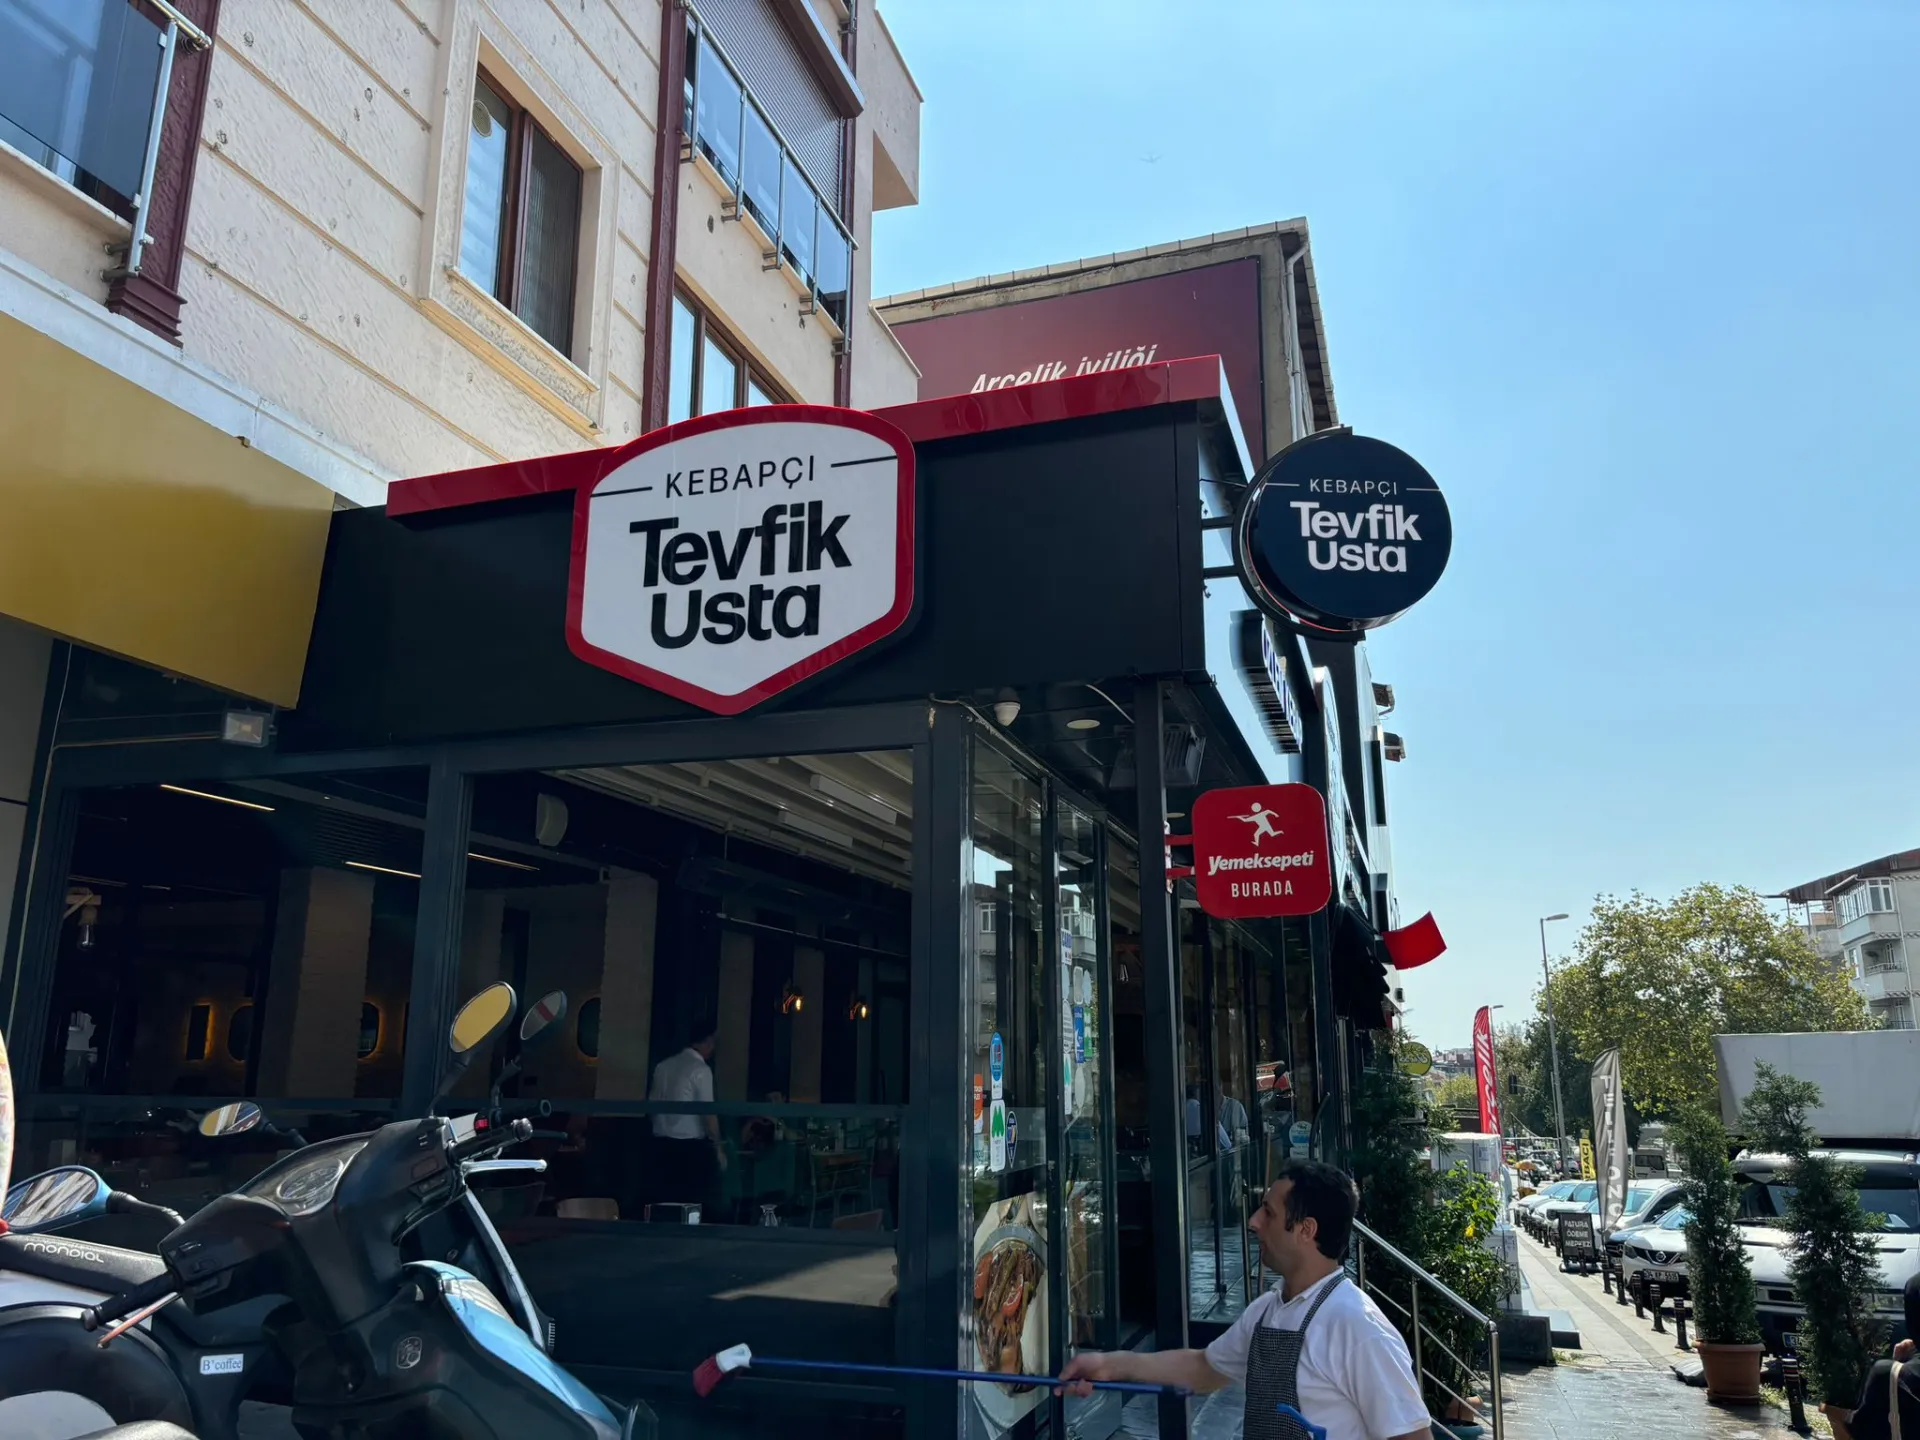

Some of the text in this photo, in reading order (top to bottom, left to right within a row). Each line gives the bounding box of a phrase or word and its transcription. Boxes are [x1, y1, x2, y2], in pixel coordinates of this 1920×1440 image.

[666, 455, 814, 498] KEBAPÇI
[1309, 478, 1397, 497] KEBAPÇI
[1290, 501, 1422, 541] Tevfik
[629, 500, 852, 587] Tevfik
[1307, 540, 1407, 572] Usta
[650, 583, 821, 649] Usta
[1231, 880, 1293, 897] BURADA
[1564, 1220, 1588, 1228] FATURA
